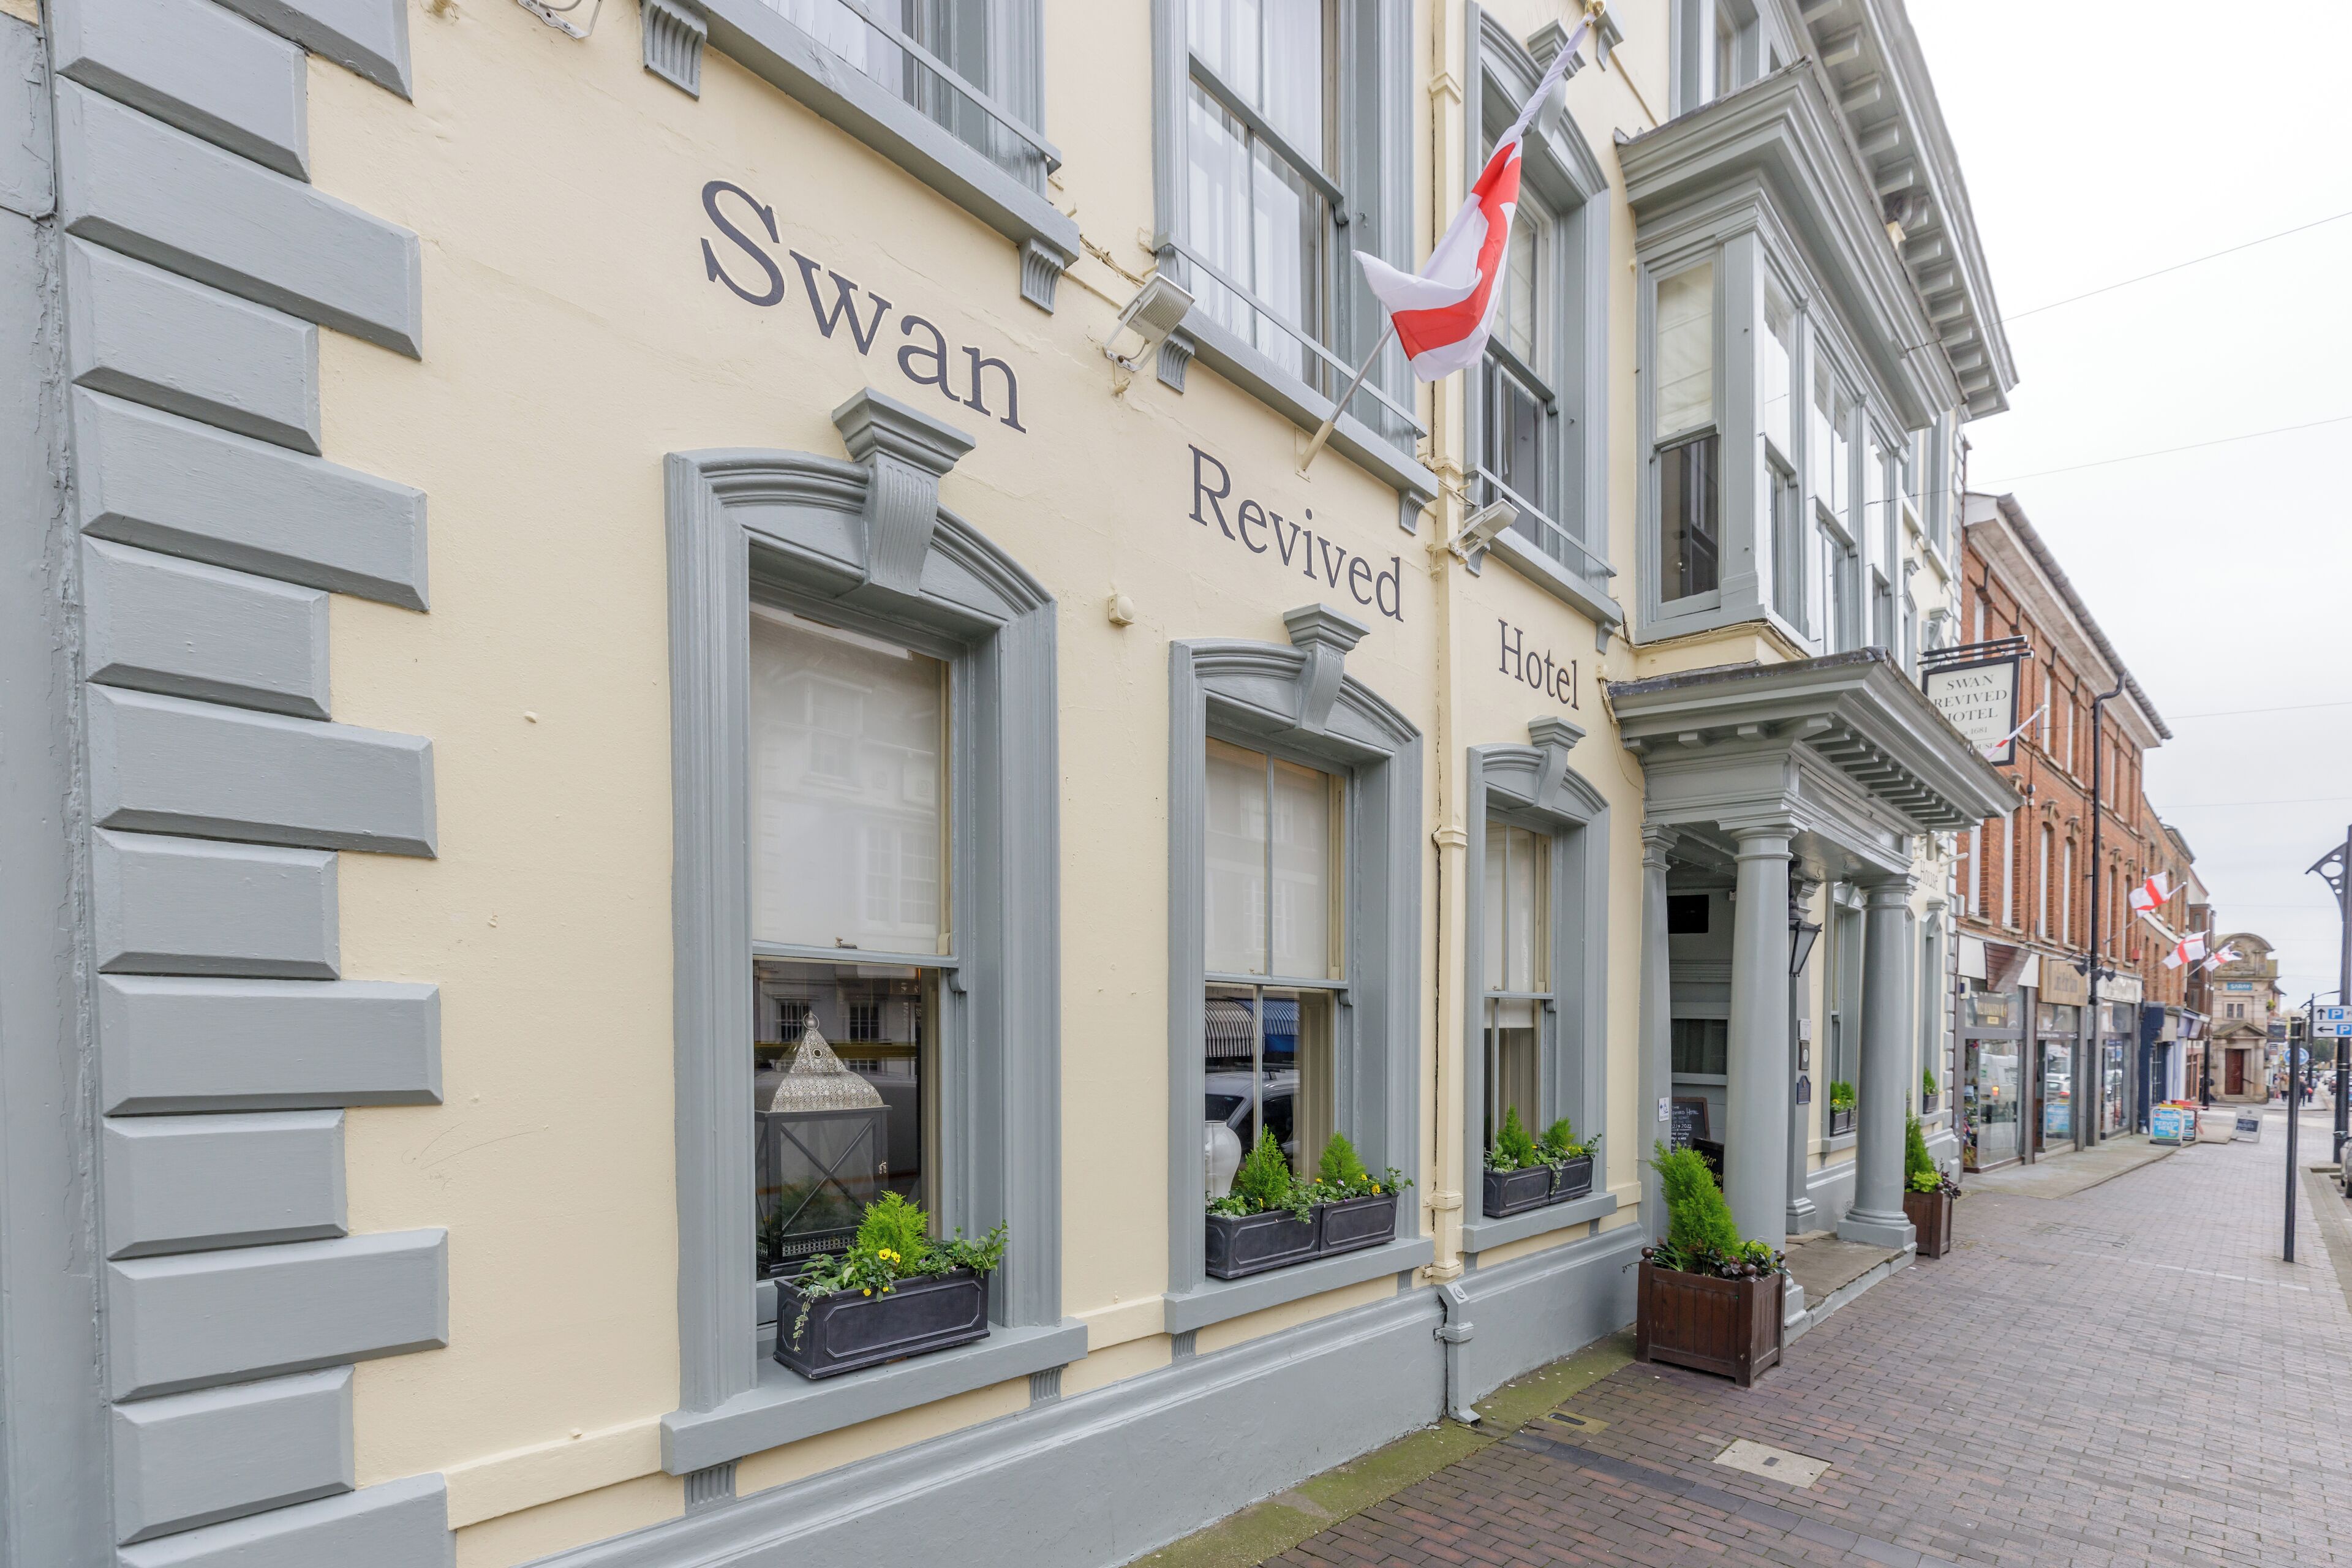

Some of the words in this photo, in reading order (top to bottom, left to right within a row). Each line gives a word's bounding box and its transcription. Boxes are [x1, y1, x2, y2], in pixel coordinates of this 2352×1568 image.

[701, 179, 1027, 434] Swan
[1188, 443, 1404, 623] Revived
[1498, 618, 1579, 710] Hotel
[1947, 674, 1994, 691] SWAN
[1934, 690, 2008, 708] REVIVED
[1920, 860, 1939, 891] House
[2331, 1009, 2342, 1019] P
[2340, 1025, 2350, 1035] P
